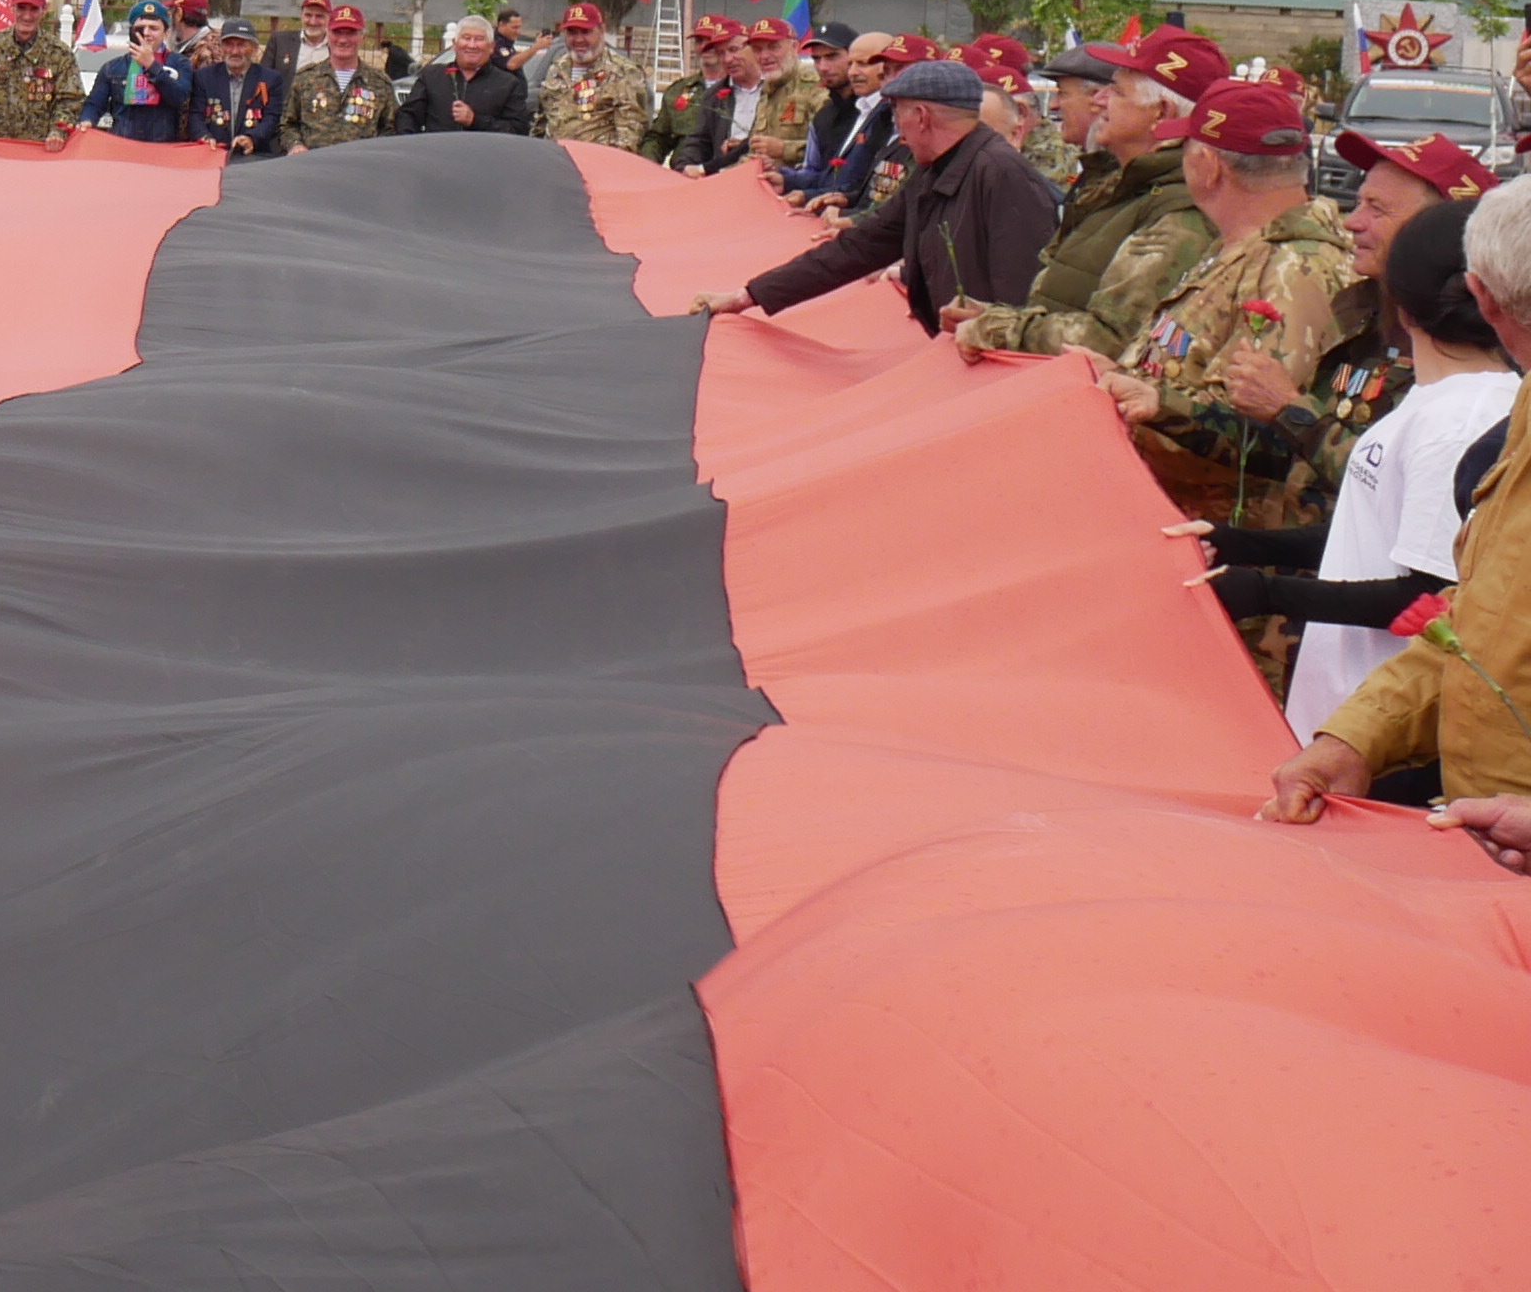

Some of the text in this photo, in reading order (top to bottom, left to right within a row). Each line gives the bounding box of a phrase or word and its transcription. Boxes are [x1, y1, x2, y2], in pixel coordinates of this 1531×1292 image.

[1155, 50, 1189, 82] Z
[998, 75, 1020, 93] Z
[1200, 109, 1227, 139] Z
[1448, 173, 1481, 202] Z
